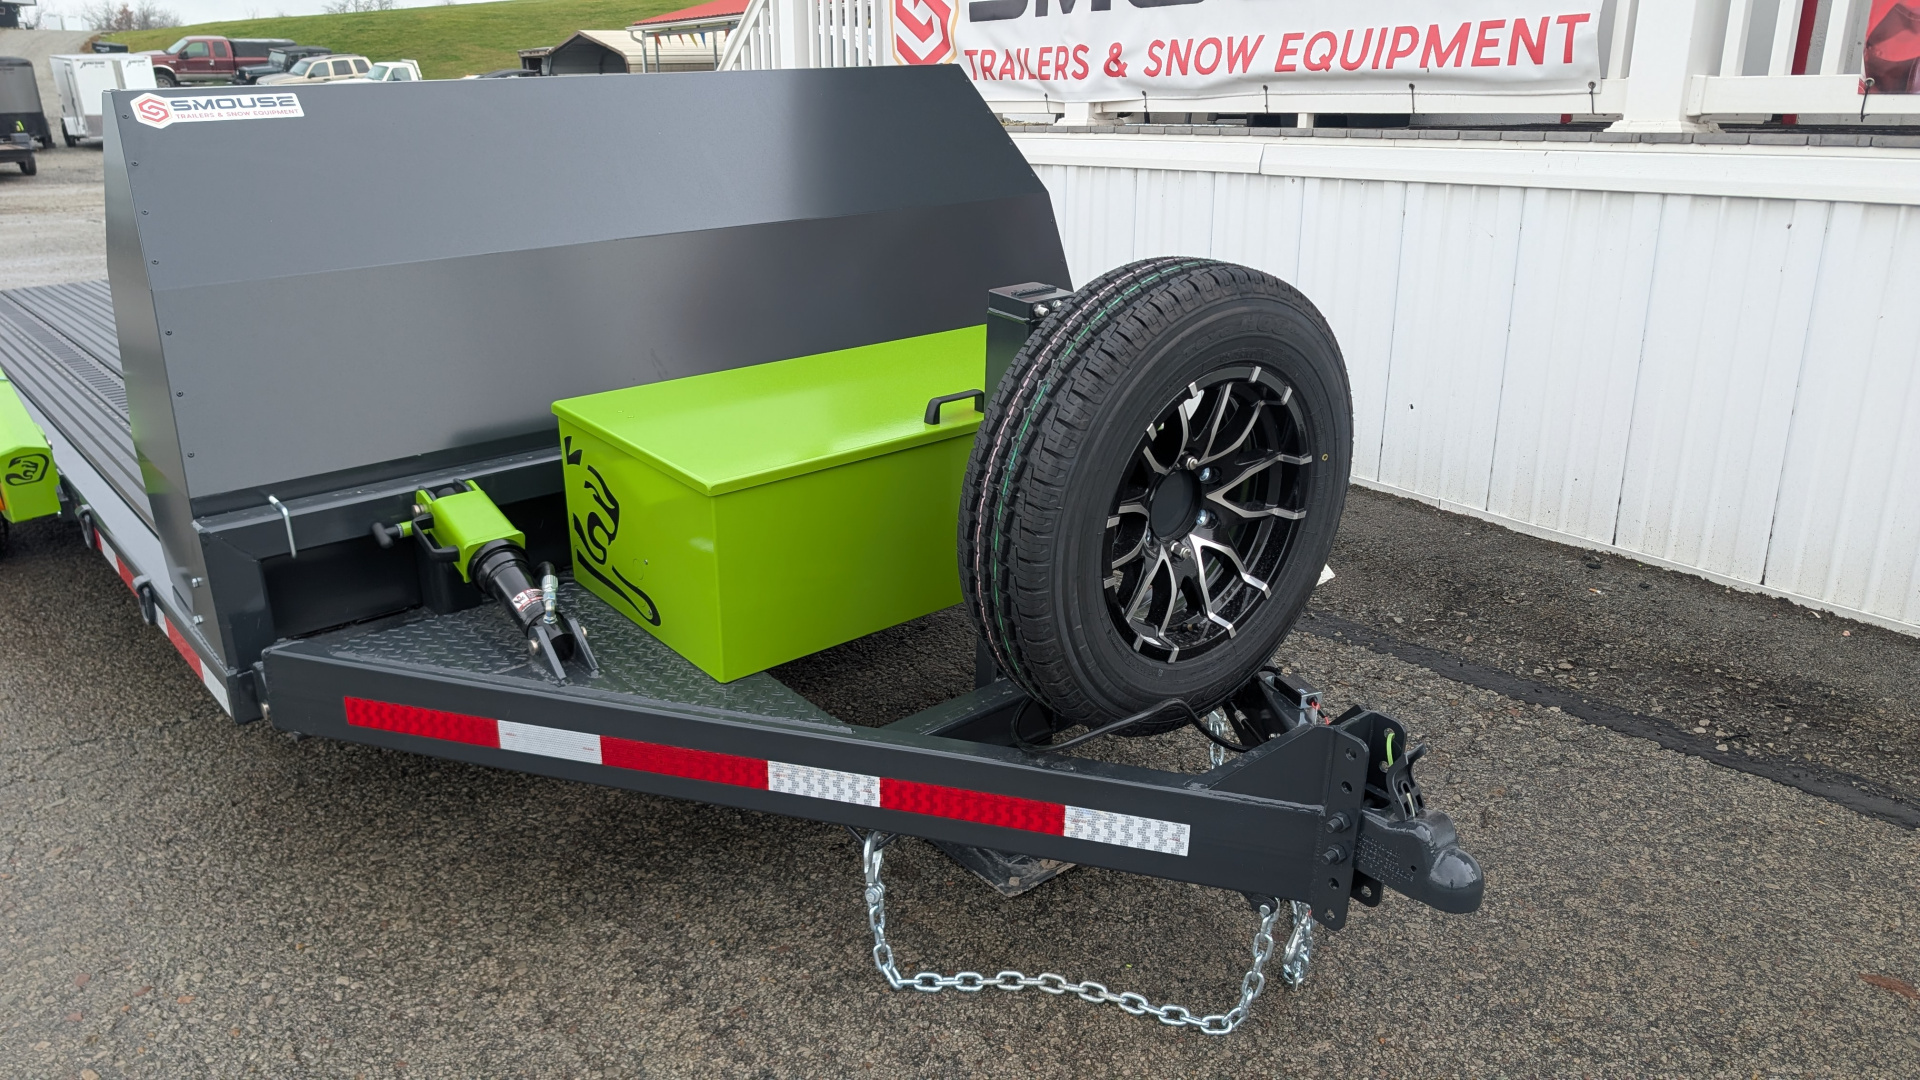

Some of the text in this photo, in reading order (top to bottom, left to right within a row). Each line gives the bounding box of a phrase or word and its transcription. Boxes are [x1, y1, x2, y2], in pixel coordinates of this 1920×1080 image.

[964, 13, 1591, 81] TRAILERS & SNOW EQUIPMENT
[170, 95, 297, 111] SMOUSE
[175, 112, 215, 120] TRAILERS
[226, 110, 251, 118] SNOW
[253, 108, 300, 117] EQUIPMENT
